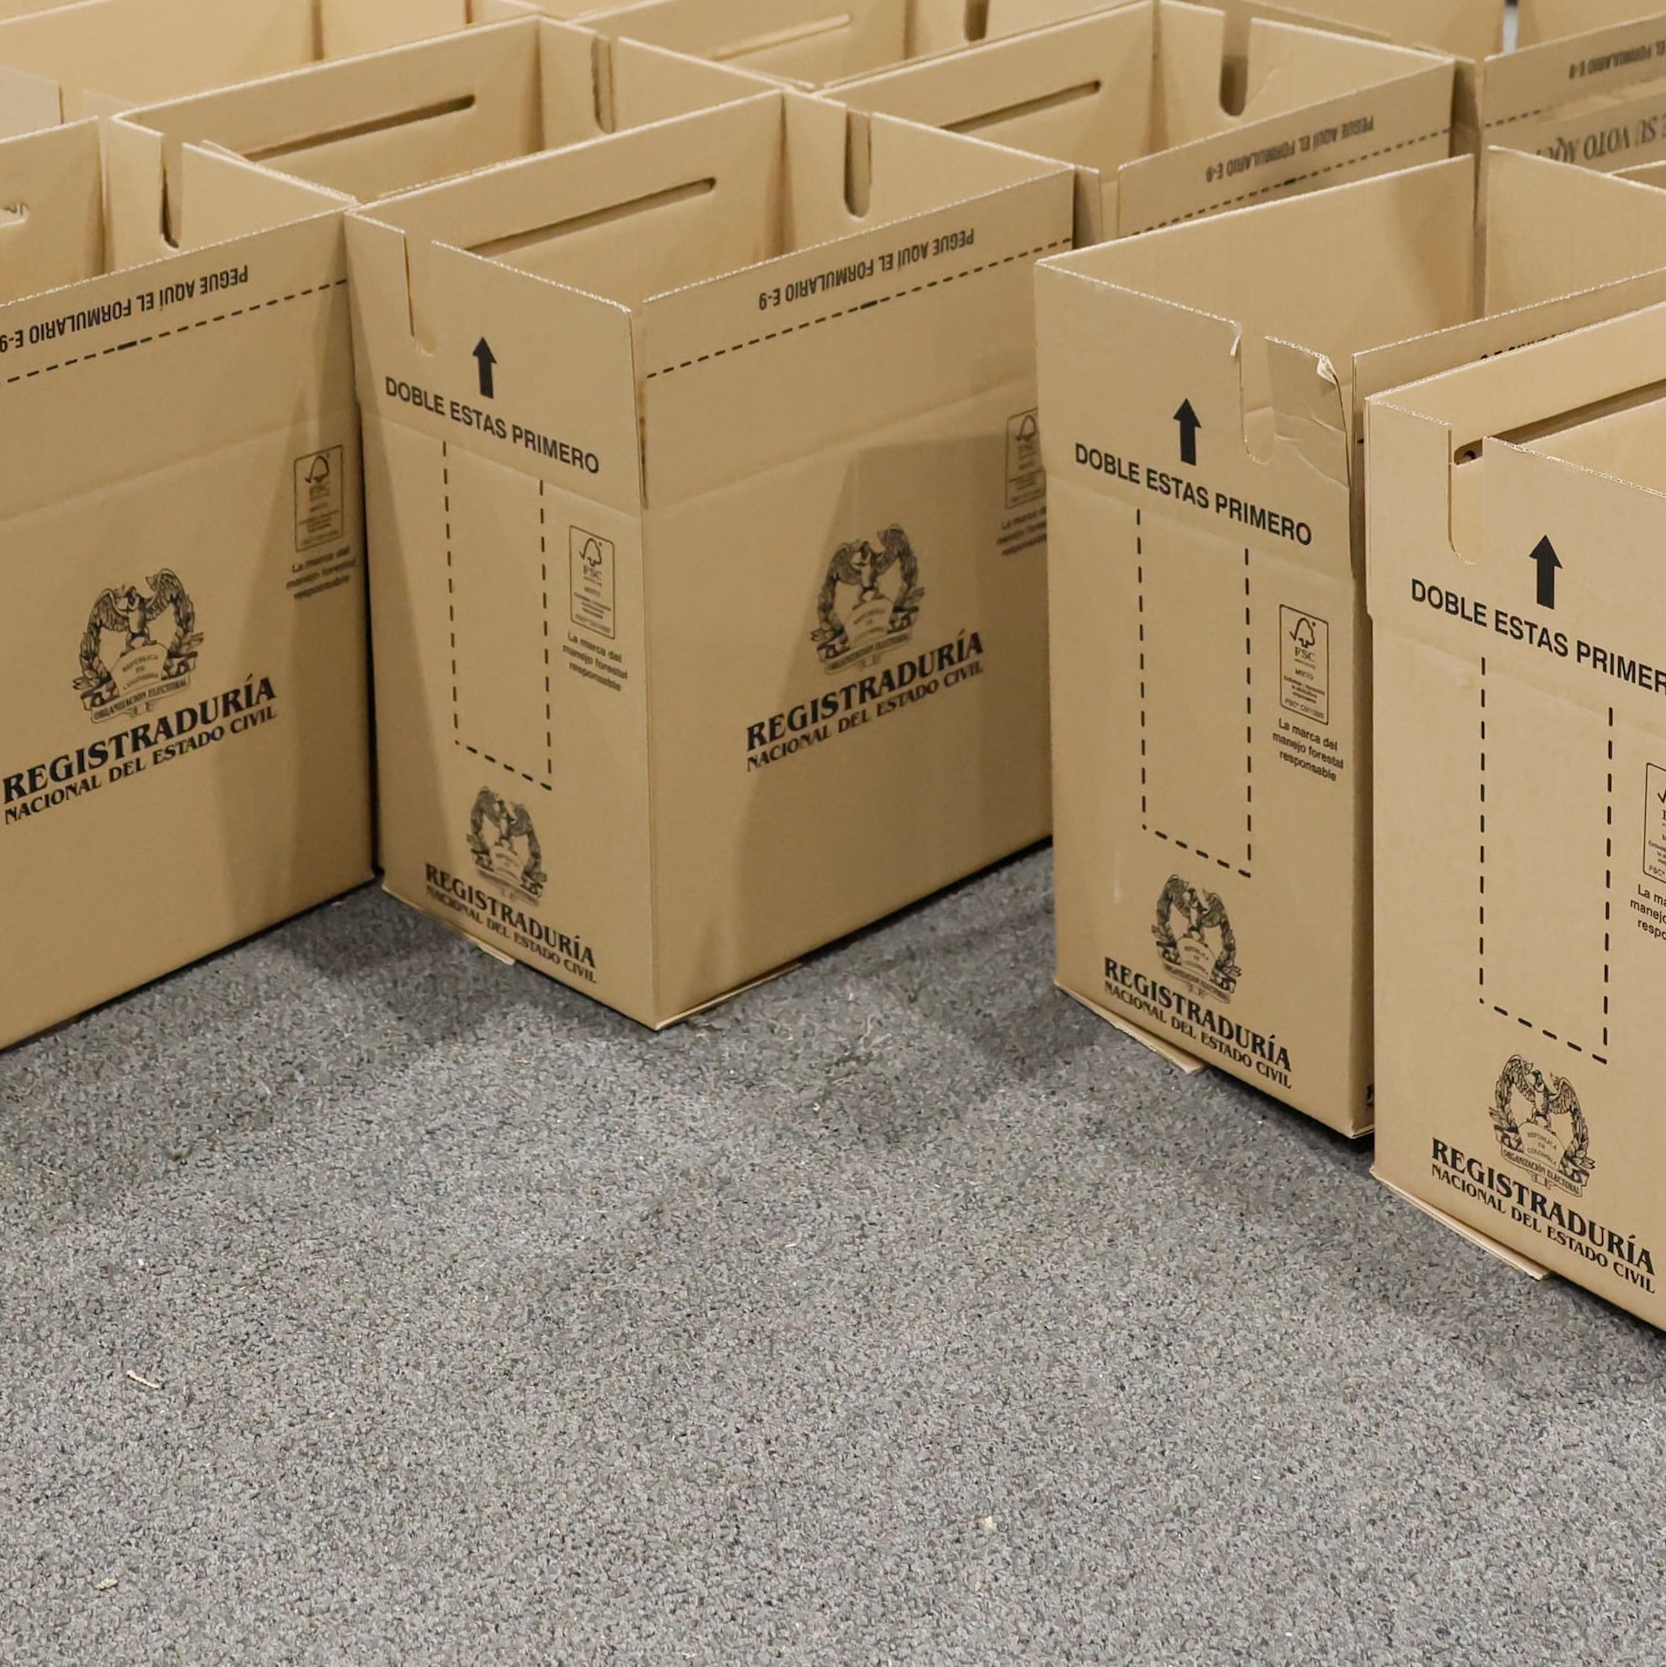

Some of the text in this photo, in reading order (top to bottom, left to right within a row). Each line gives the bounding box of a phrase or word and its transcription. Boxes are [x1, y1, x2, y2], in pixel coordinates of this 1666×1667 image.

[1584, 125, 1631, 161] VOTO
[877, 252, 894, 272] EL
[932, 227, 975, 257] PEGUE
[136, 291, 154, 312] EL
[159, 279, 195, 307] AQUÍ
[199, 264, 248, 295] PEGUE
[758, 287, 781, 311] E-9
[785, 258, 875, 303] FORMULARIO
[29, 297, 132, 345] FORMULARIO
[385, 376, 600, 474] DOBLE ESTAS PRIMERO
[1075, 442, 1312, 546] DOBLE ESTAS PRIMERO
[1411, 578, 1487, 628] DOBLE
[1494, 609, 1569, 658] ESTAS
[1294, 646, 1315, 662] FSC
[746, 632, 984, 751] REGISTRADURÍA
[2, 677, 276, 803] REGISTRADURÍA
[747, 663, 982, 773] NACIONAL DEL ESTADO CIVIL
[1279, 717, 1337, 751] La marca del
[4, 706, 275, 825] NACIONAL DEL ESTADO CIVIL
[1273, 731, 1344, 769] manejo forestal
[1279, 750, 1336, 781] responsable
[1638, 884, 1650, 899] La
[425, 863, 596, 969] REGISTRADURÍA
[487, 917, 596, 984] DEL ESTADO CIVIL
[1104, 957, 1292, 1073] REGISTRADURÍA
[1105, 983, 1292, 1090] NACIONAL DEL ESTADO CIVIL
[1431, 1137, 1655, 1276] REGISTRADURÍA
[1431, 1164, 1656, 1294] NACIONAL DEL ESTADO CIVIL
